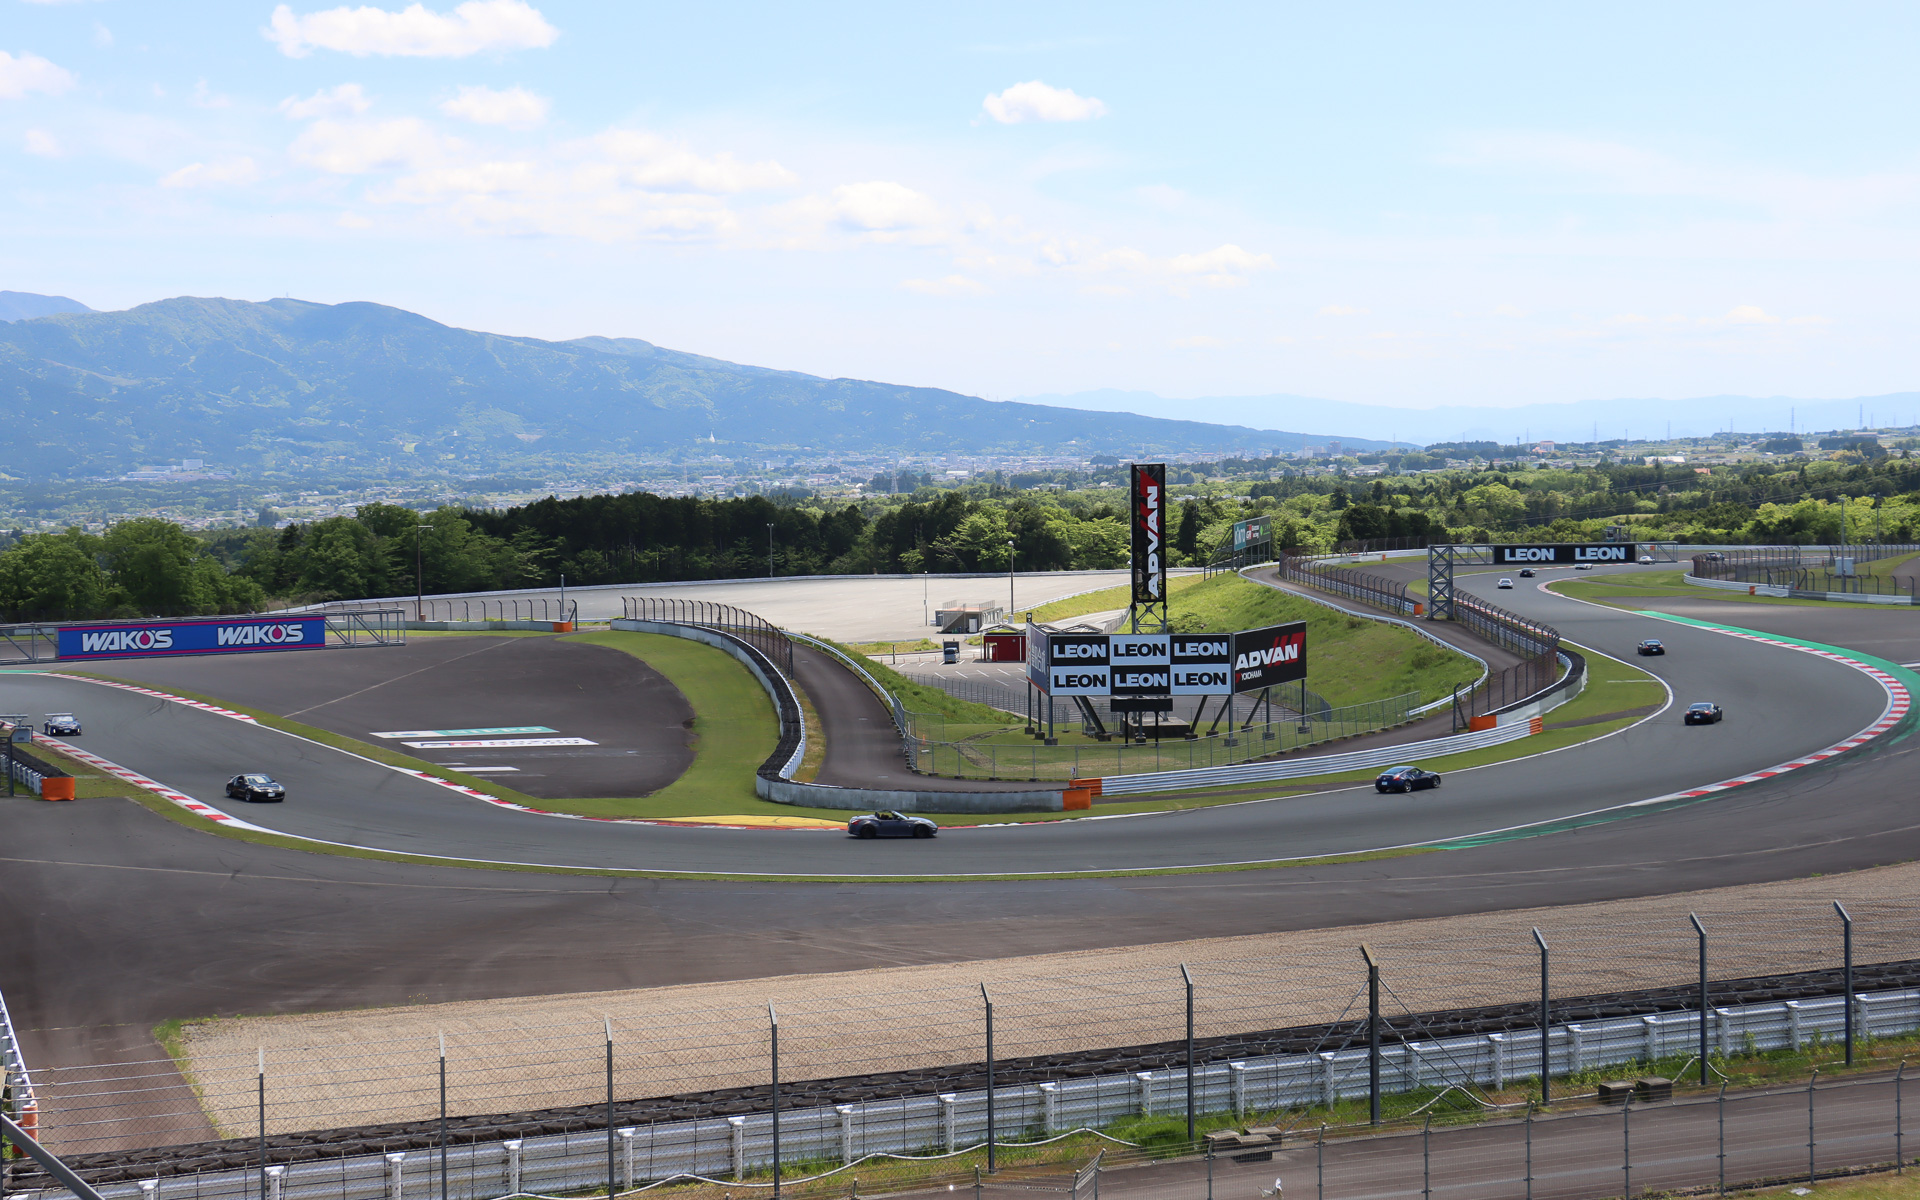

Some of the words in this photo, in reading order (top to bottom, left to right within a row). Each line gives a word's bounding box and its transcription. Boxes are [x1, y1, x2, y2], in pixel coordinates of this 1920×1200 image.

[1147, 485, 1159, 598] ADVAN
[1504, 548, 1555, 561] LEON
[1575, 547, 1625, 560] LEON
[1053, 644, 1107, 658] LEON
[1113, 643, 1167, 657] LEON
[1174, 641, 1228, 656] LEON
[1235, 643, 1298, 670] ADVAN
[1054, 674, 1107, 688] LEON
[1114, 673, 1168, 688] LEON
[1174, 672, 1228, 687] LEON
[1241, 669, 1262, 680] YOKOHAMA
